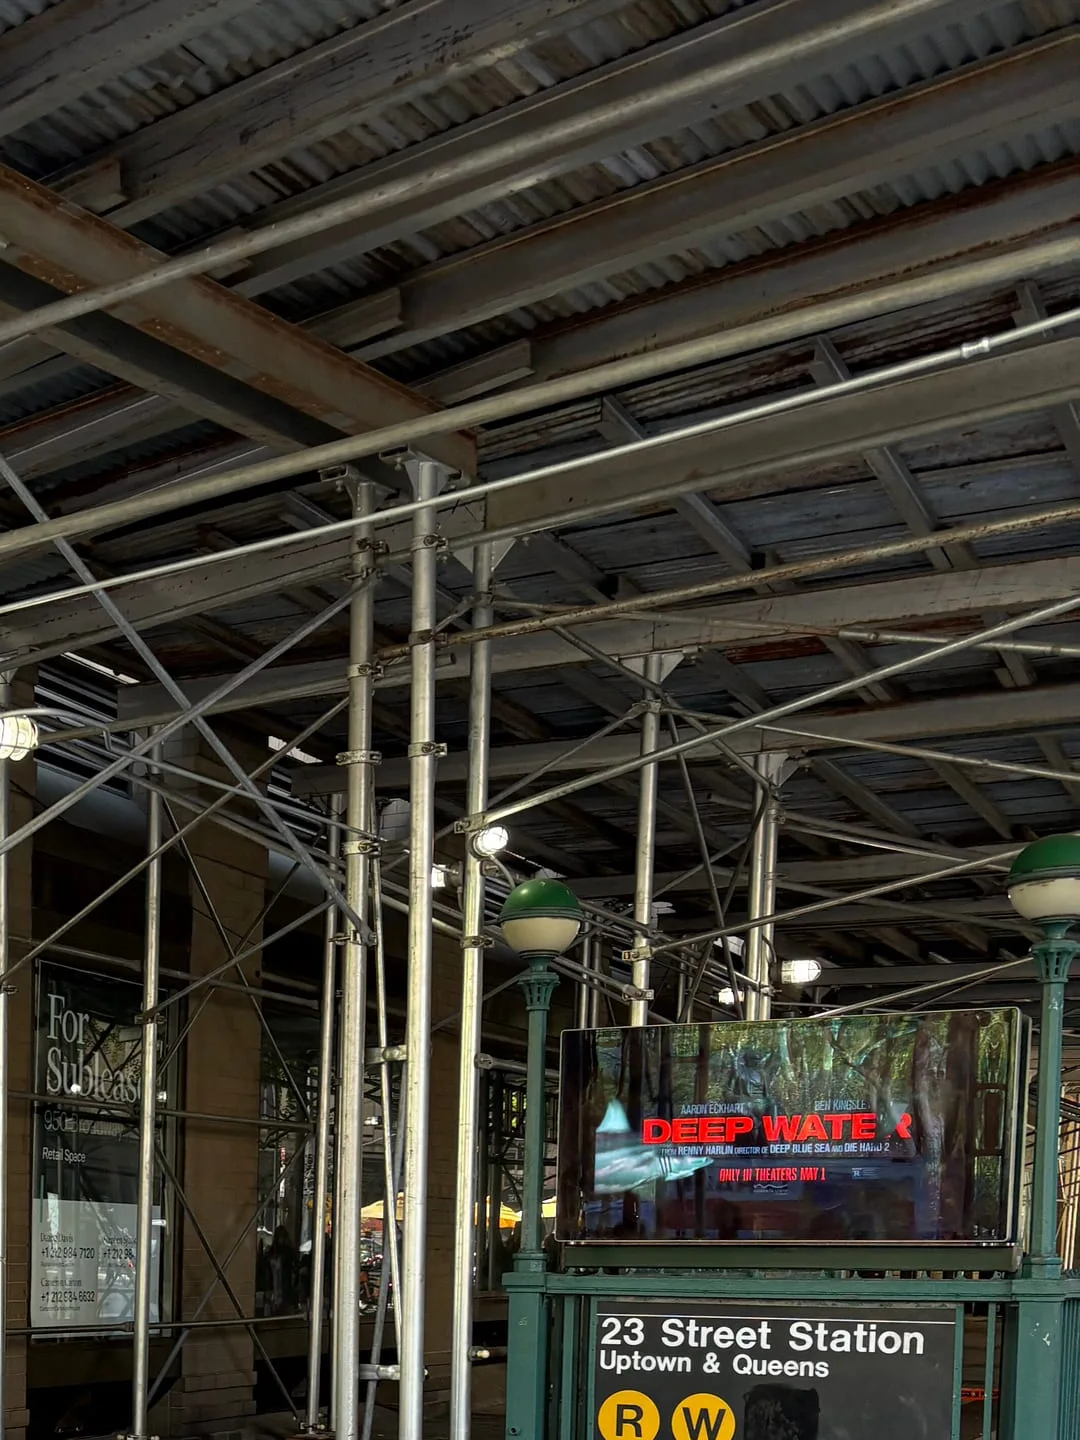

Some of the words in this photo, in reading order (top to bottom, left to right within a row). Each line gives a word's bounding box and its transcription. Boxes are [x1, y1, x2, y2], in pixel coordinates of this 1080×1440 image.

[47, 993, 89, 1044] For
[681, 1103, 707, 1115] AARON
[815, 1100, 831, 1111] BEN
[833, 1100, 867, 1110] KINGSLE
[643, 1116, 754, 1143] DEEP
[42, 1147, 64, 1160] Retail
[64, 1149, 86, 1164] Space
[705, 1145, 734, 1155] HARLIN
[770, 1144, 790, 1154] DEEP
[792, 1143, 812, 1153] BLUE
[814, 1143, 830, 1153] SEA
[844, 1143, 858, 1152] DIE
[884, 1142, 890, 1151] 2
[719, 1168, 740, 1182] ONLY
[755, 1167, 797, 1181] THEATERS
[800, 1167, 818, 1181] MAY
[820, 1167, 826, 1181] 1
[79, 1247, 95, 1259] 7120
[600, 1317, 645, 1347] 23
[661, 1318, 771, 1350] Street
[789, 1321, 924, 1355] Station
[599, 1350, 692, 1375] Uptown
[702, 1352, 721, 1374] &
[732, 1354, 830, 1378] Queens
[615, 1403, 644, 1438] R
